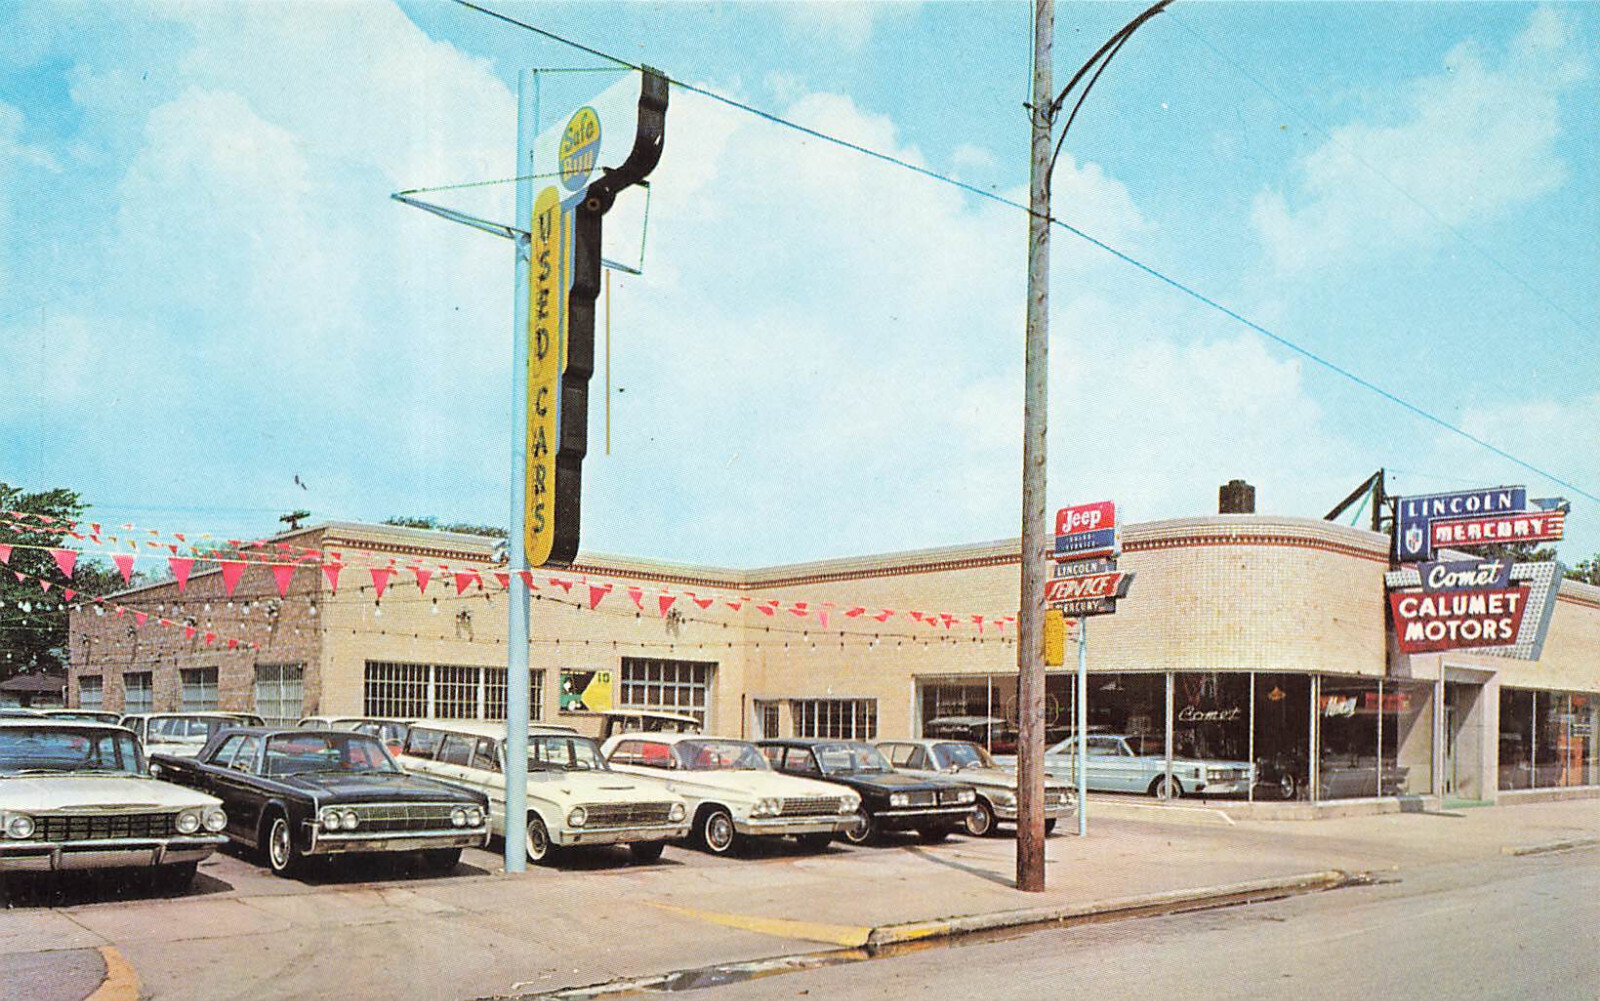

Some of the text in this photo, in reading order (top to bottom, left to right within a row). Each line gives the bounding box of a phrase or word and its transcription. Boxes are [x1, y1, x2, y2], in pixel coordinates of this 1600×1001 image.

[562, 112, 595, 152] Safe
[533, 210, 552, 533] USED CARS
[1408, 491, 1512, 517] LINCOLN
[1062, 509, 1102, 533] Jeep
[1436, 518, 1544, 542] MERCURY
[1057, 561, 1099, 577] LINCOLN
[1429, 561, 1505, 589] Comet
[1047, 576, 1112, 599] SERVICE
[1399, 592, 1521, 618] CALUMET
[1404, 618, 1513, 641] MOTORS
[1178, 706, 1242, 722] Comet
